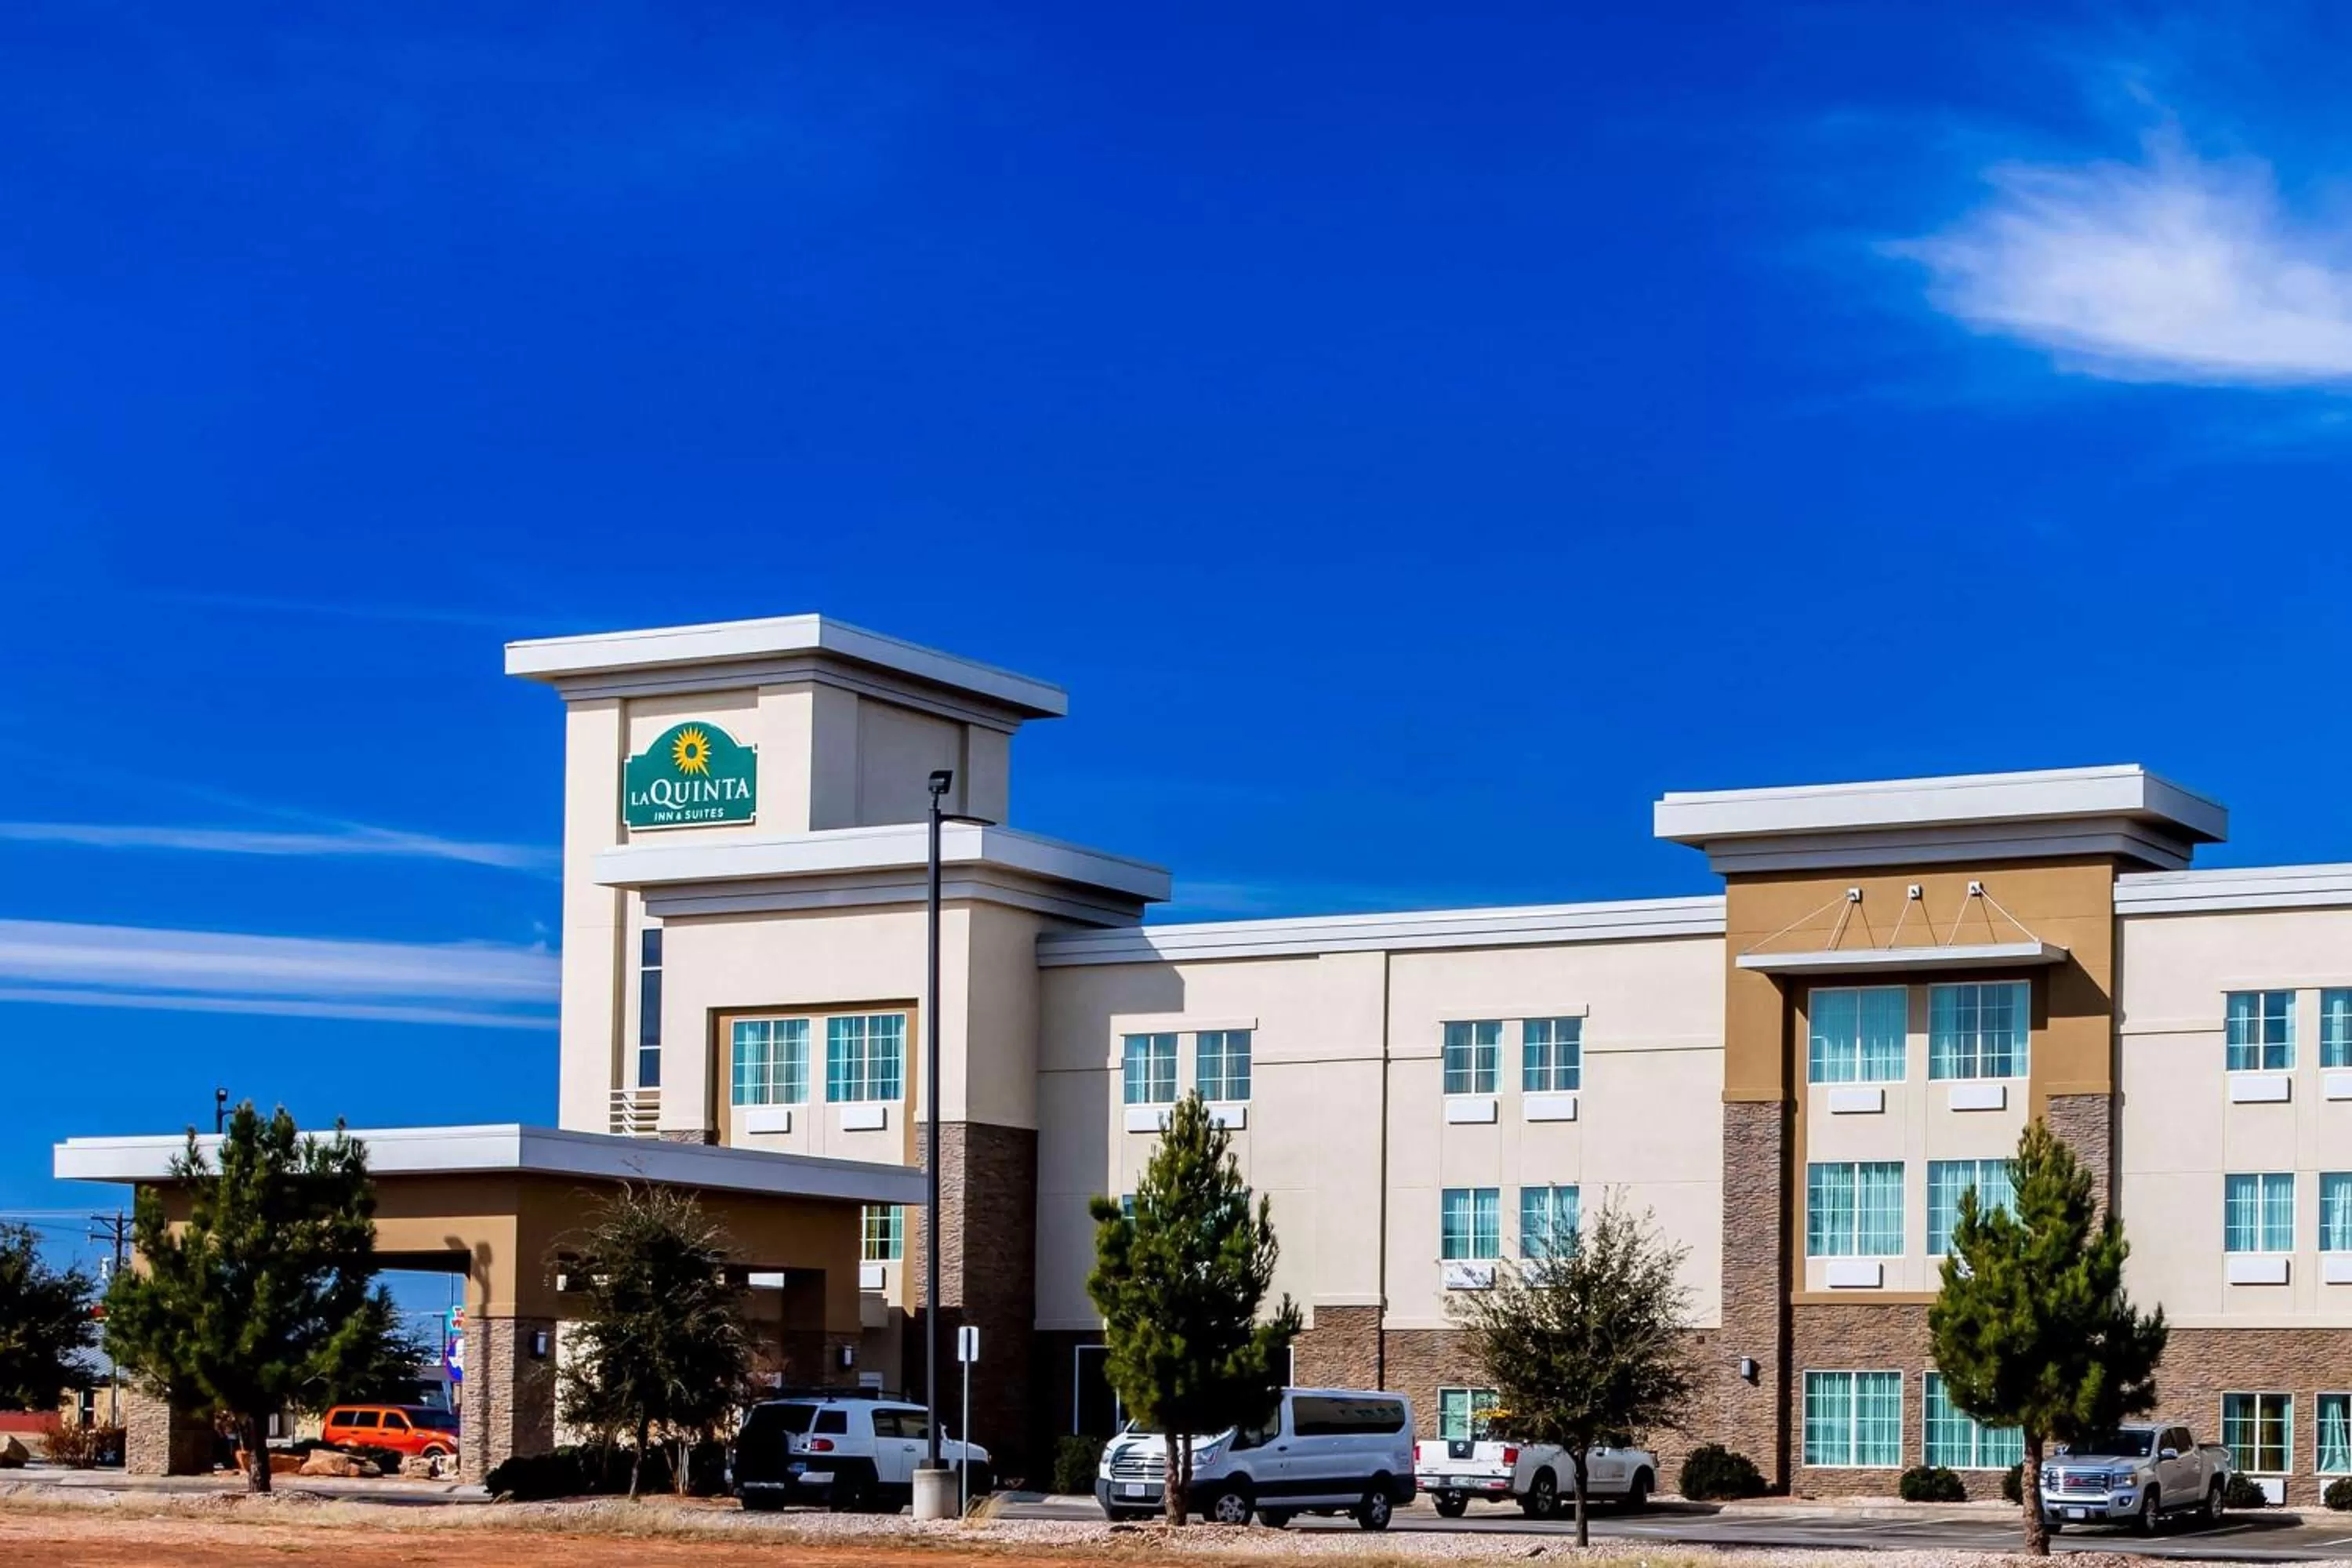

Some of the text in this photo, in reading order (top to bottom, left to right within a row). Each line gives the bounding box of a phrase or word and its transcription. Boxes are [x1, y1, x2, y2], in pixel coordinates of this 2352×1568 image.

[631, 778, 750, 810] LA QUINTA
[654, 808, 724, 822] INN & SUITES
